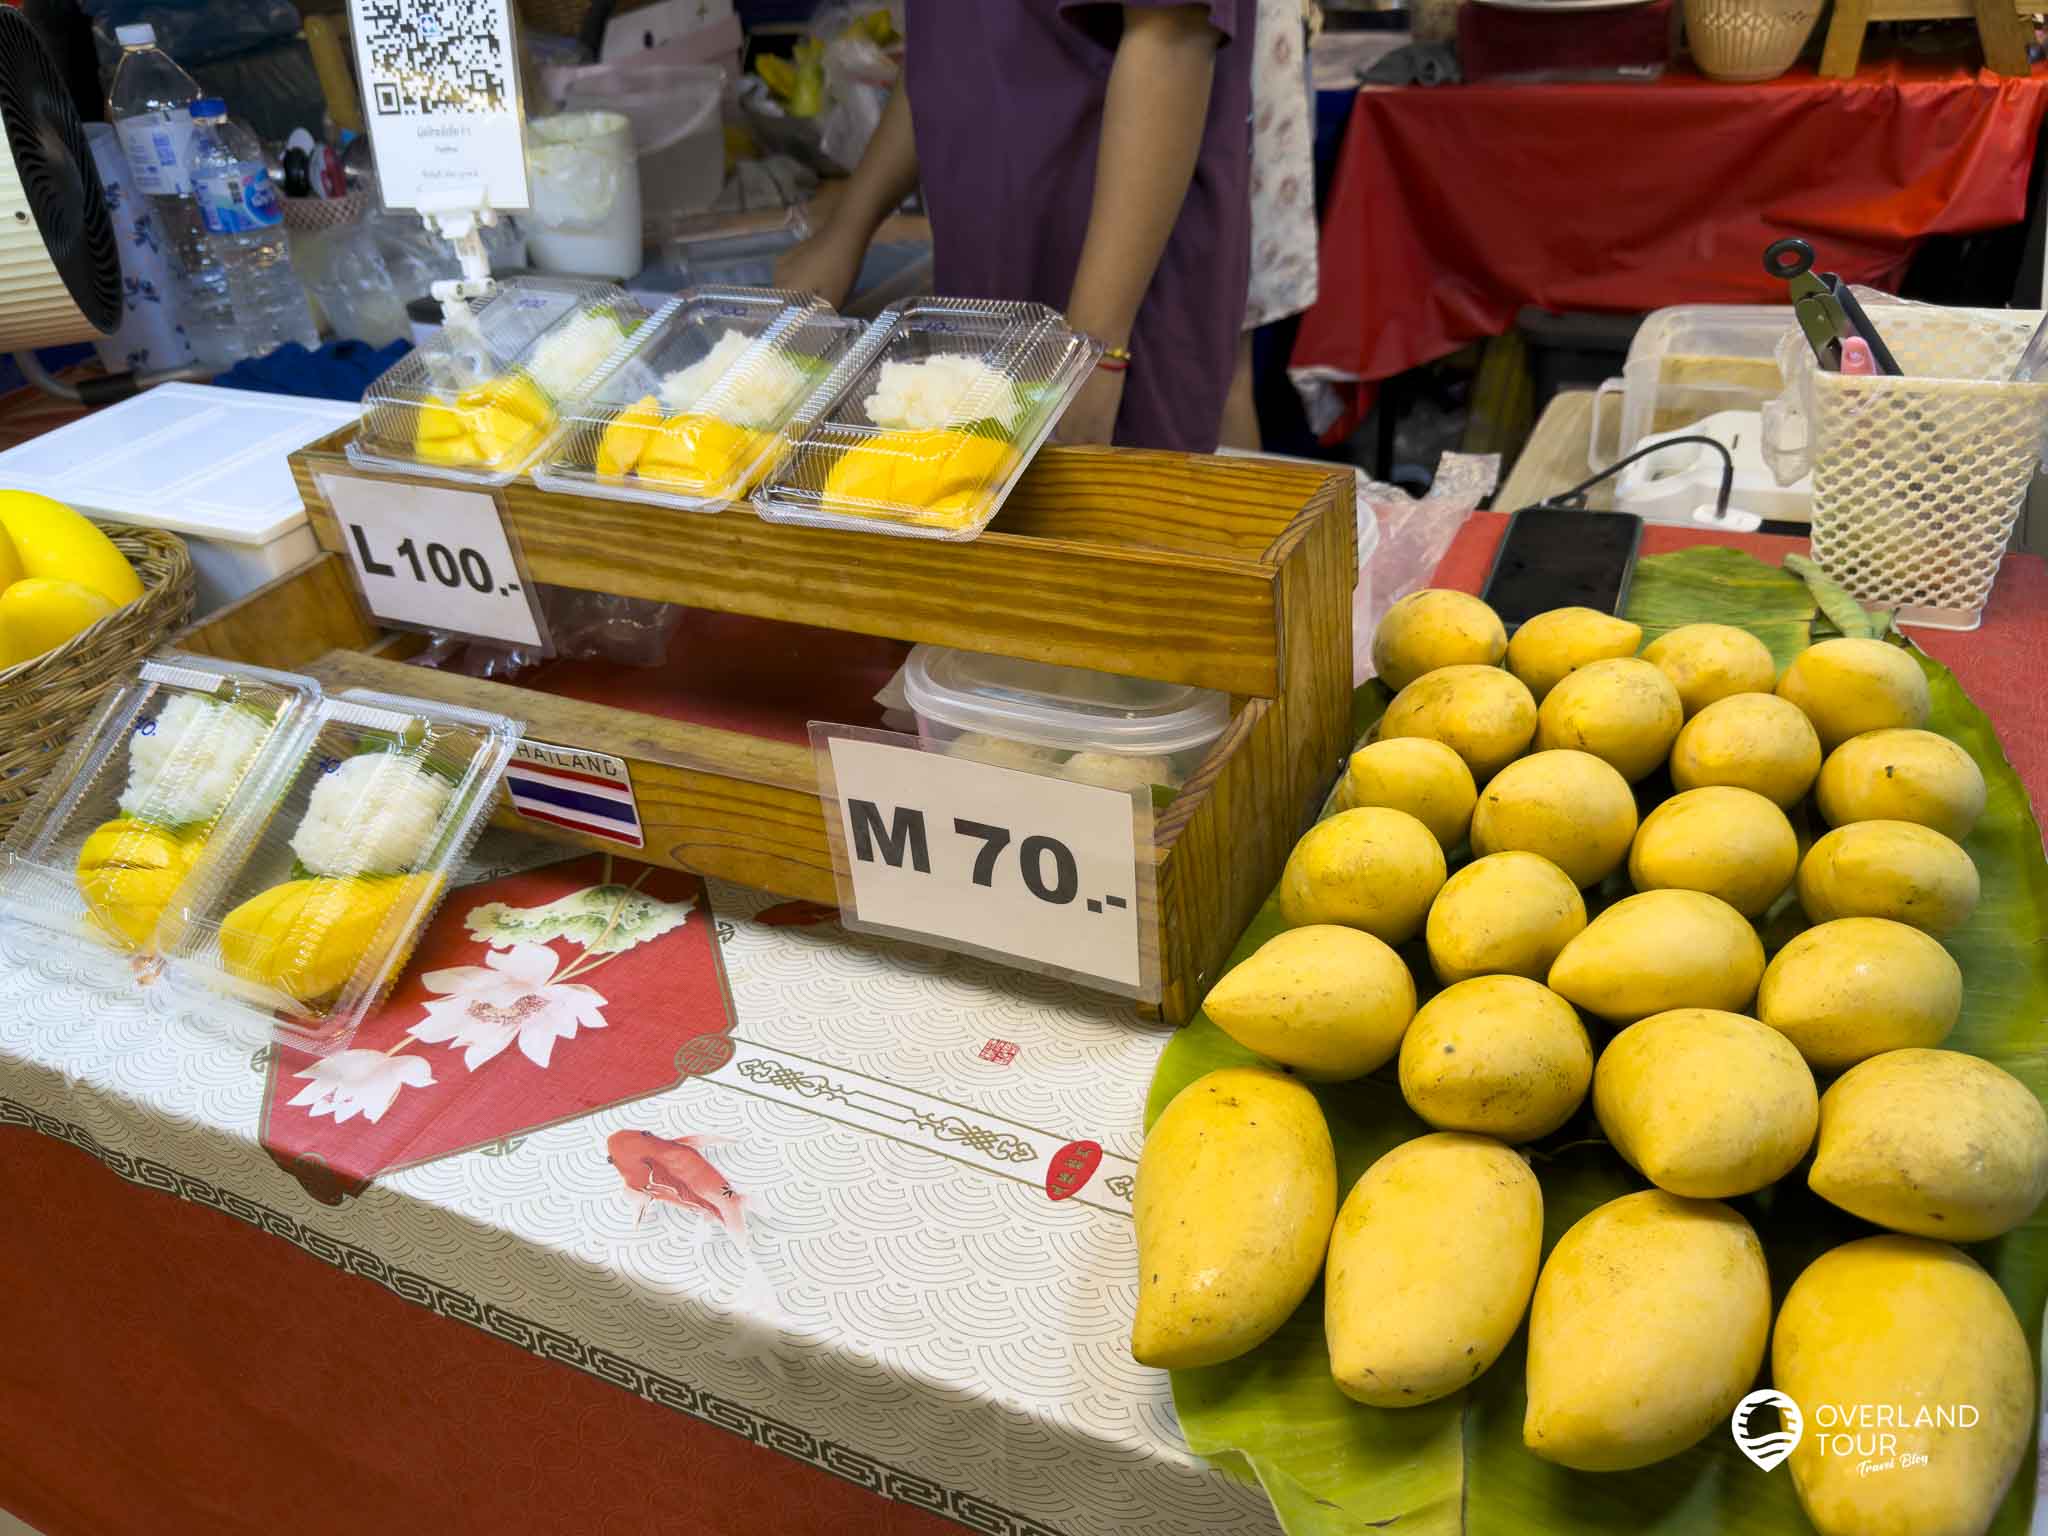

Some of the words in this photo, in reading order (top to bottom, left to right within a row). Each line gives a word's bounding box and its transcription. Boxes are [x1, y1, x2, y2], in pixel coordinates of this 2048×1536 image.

[516, 743, 617, 776] HAILAND
[847, 798, 931, 874] M
[953, 817, 1127, 914] 70.-
